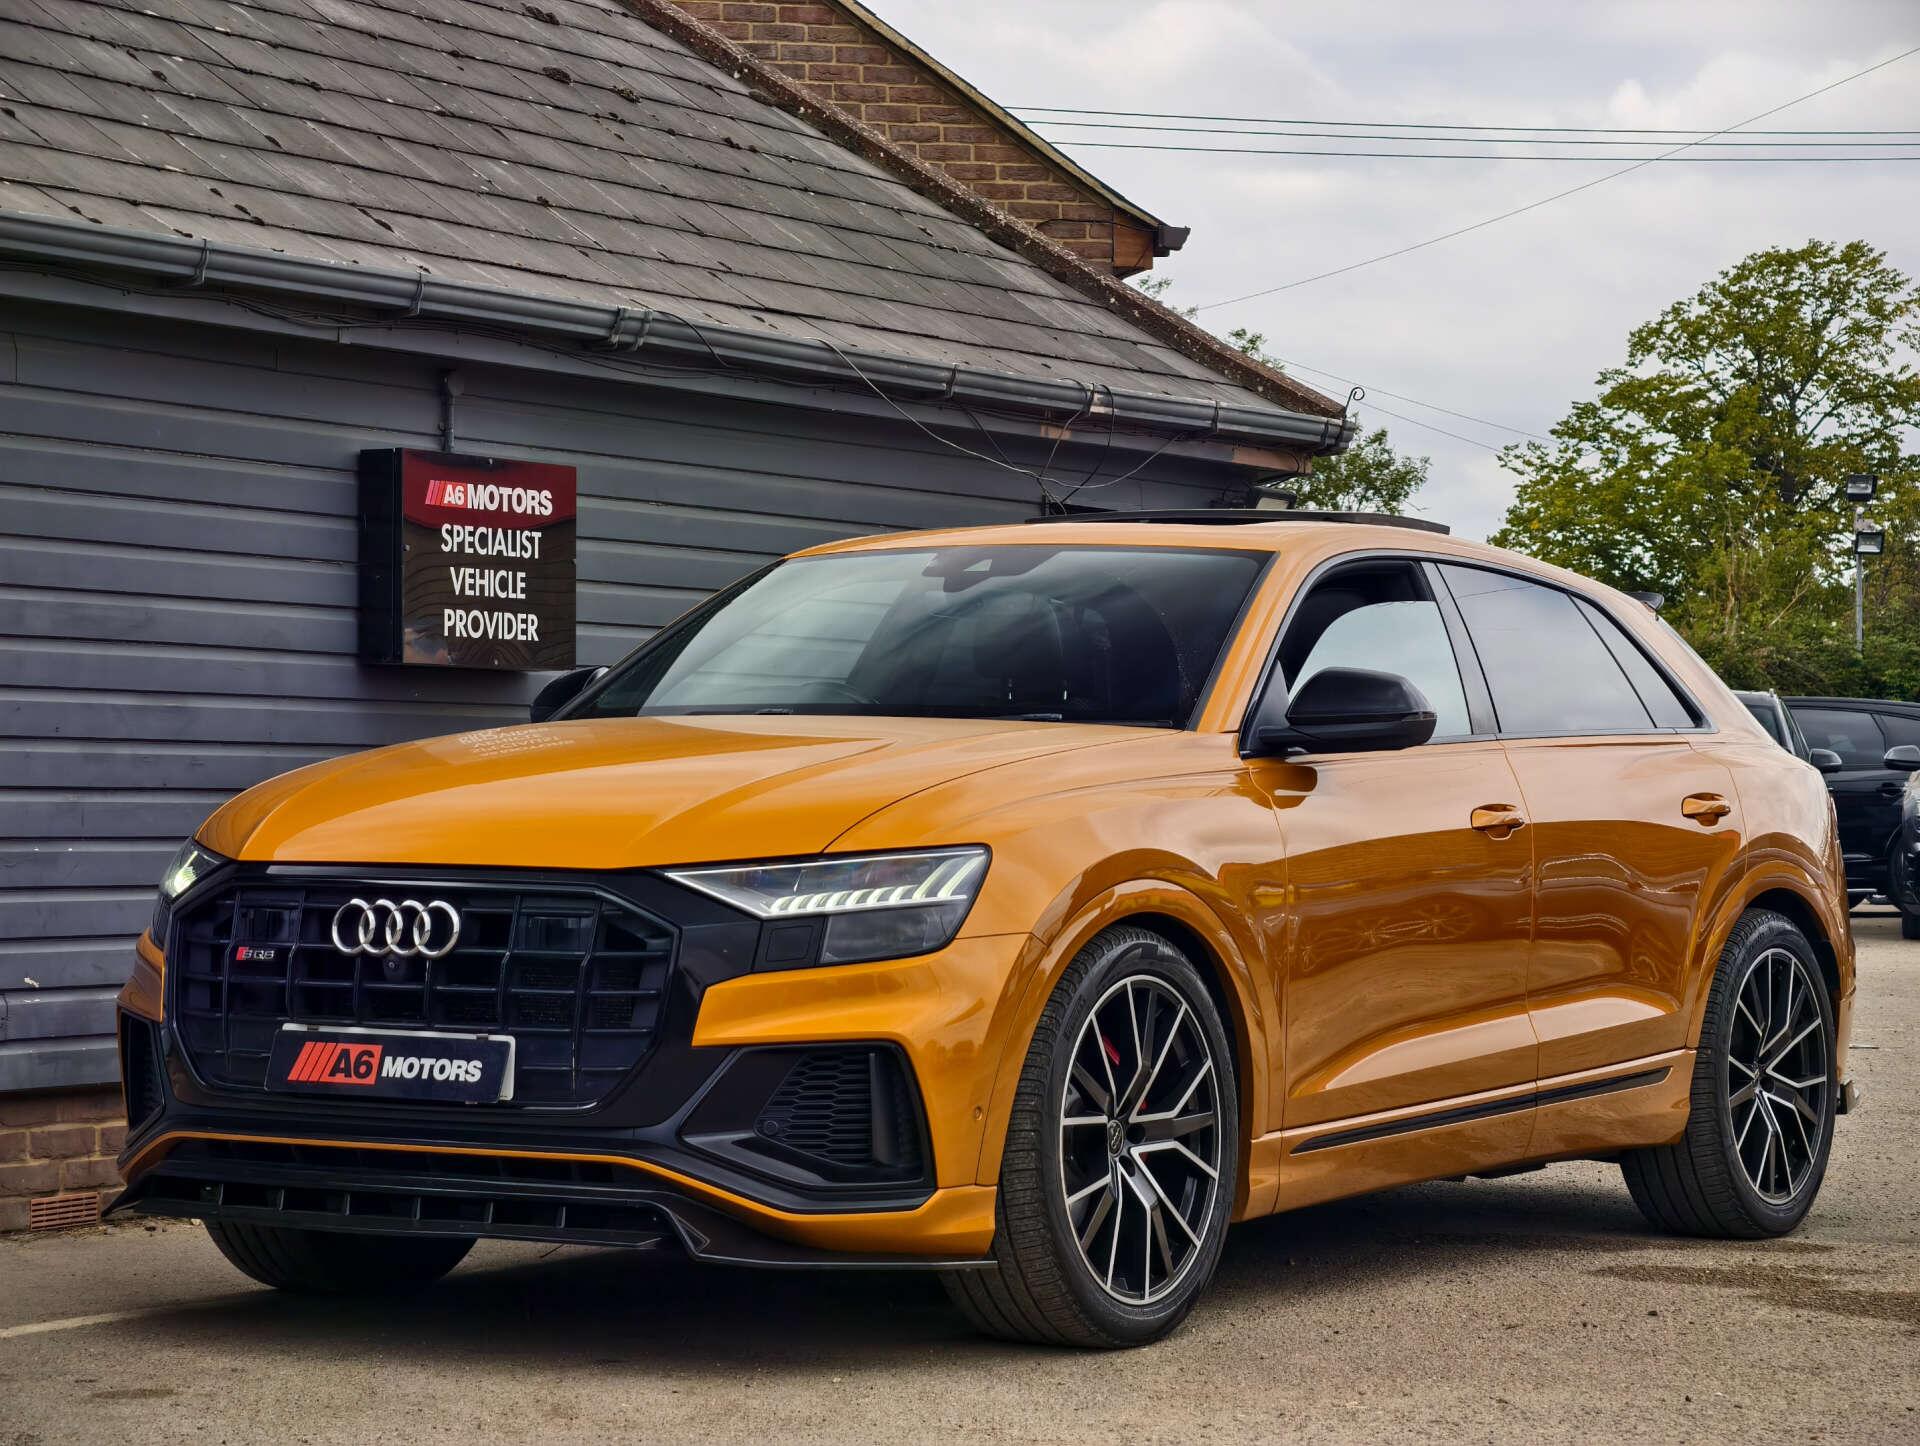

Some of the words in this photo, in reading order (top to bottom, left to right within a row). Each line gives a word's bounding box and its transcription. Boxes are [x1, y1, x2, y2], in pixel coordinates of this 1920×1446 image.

[440, 523, 542, 559] SPECIALIST
[449, 566, 526, 599] VEHICLE
[443, 608, 540, 642] PROVIDER
[328, 1048, 375, 1080] A6
[381, 1055, 483, 1083] MOTORS
